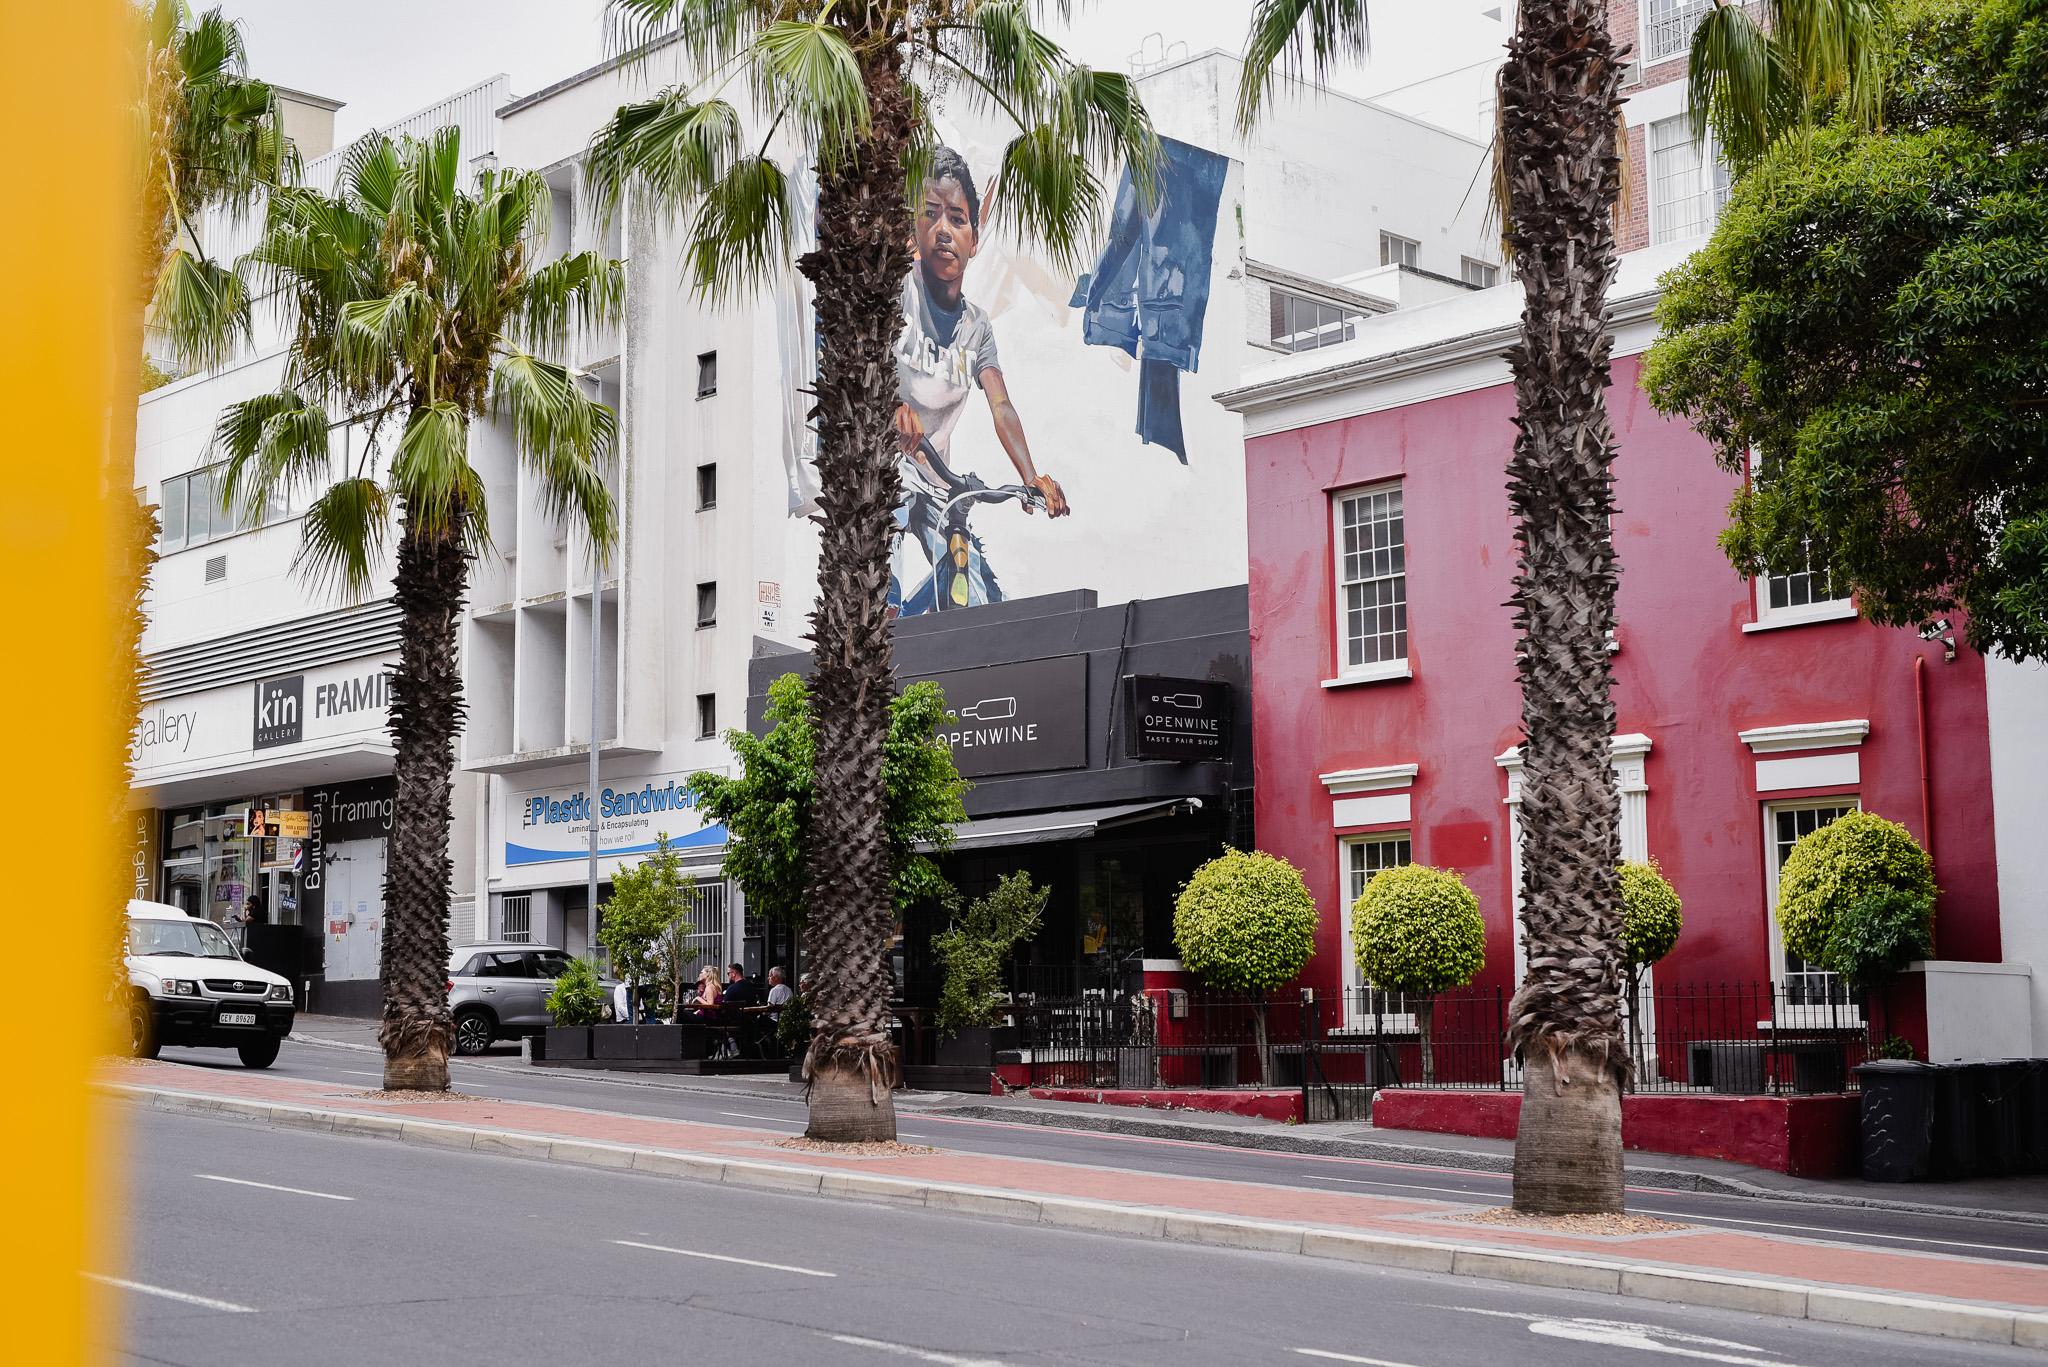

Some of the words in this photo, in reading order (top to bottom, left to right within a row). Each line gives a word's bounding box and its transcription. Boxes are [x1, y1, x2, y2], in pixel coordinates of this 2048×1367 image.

[131, 708, 197, 762] gallery
[257, 728, 297, 742] GALLERY
[1144, 714, 1219, 731] OPENWINE
[935, 723, 1038, 751] OPENWINE
[1145, 735, 1171, 743] TASTE
[1175, 737, 1194, 745] PAIR
[331, 791, 394, 830] framing
[523, 797, 532, 830] The
[137, 815, 149, 846] art
[607, 818, 649, 832] Encapsulating
[305, 790, 328, 890] framing
[282, 901, 296, 910] OPEN
